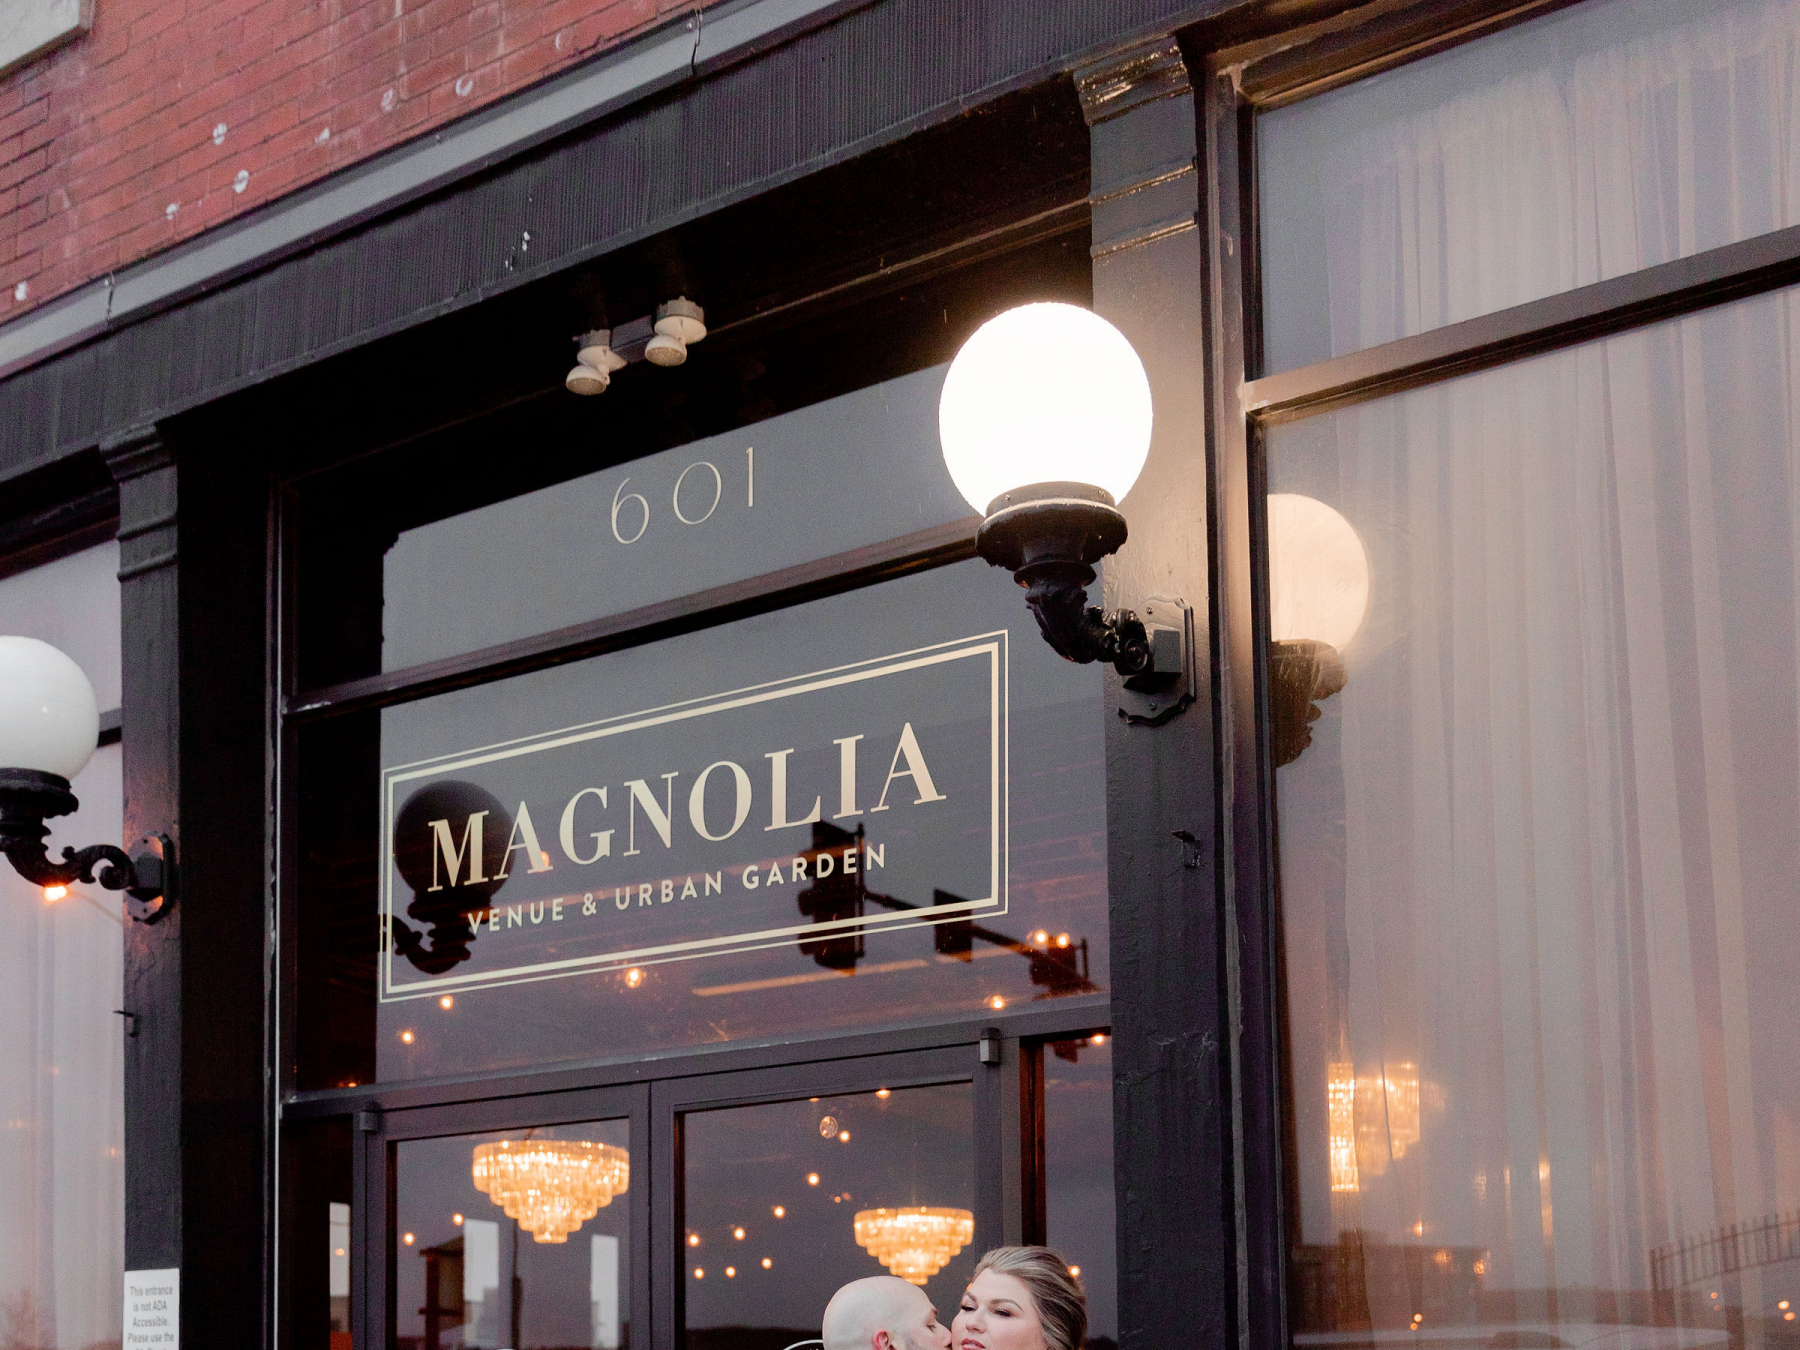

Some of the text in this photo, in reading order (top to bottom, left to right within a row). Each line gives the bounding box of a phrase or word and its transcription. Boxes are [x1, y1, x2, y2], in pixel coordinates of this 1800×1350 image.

[612, 446, 753, 544] 601
[427, 722, 946, 893] MAGNOLIA
[468, 843, 887, 934] VENUE & URBAN GARDEN
[129, 1285, 173, 1297] This entrance
[133, 1300, 167, 1312] is not ADA
[127, 1331, 175, 1343] Please use the
